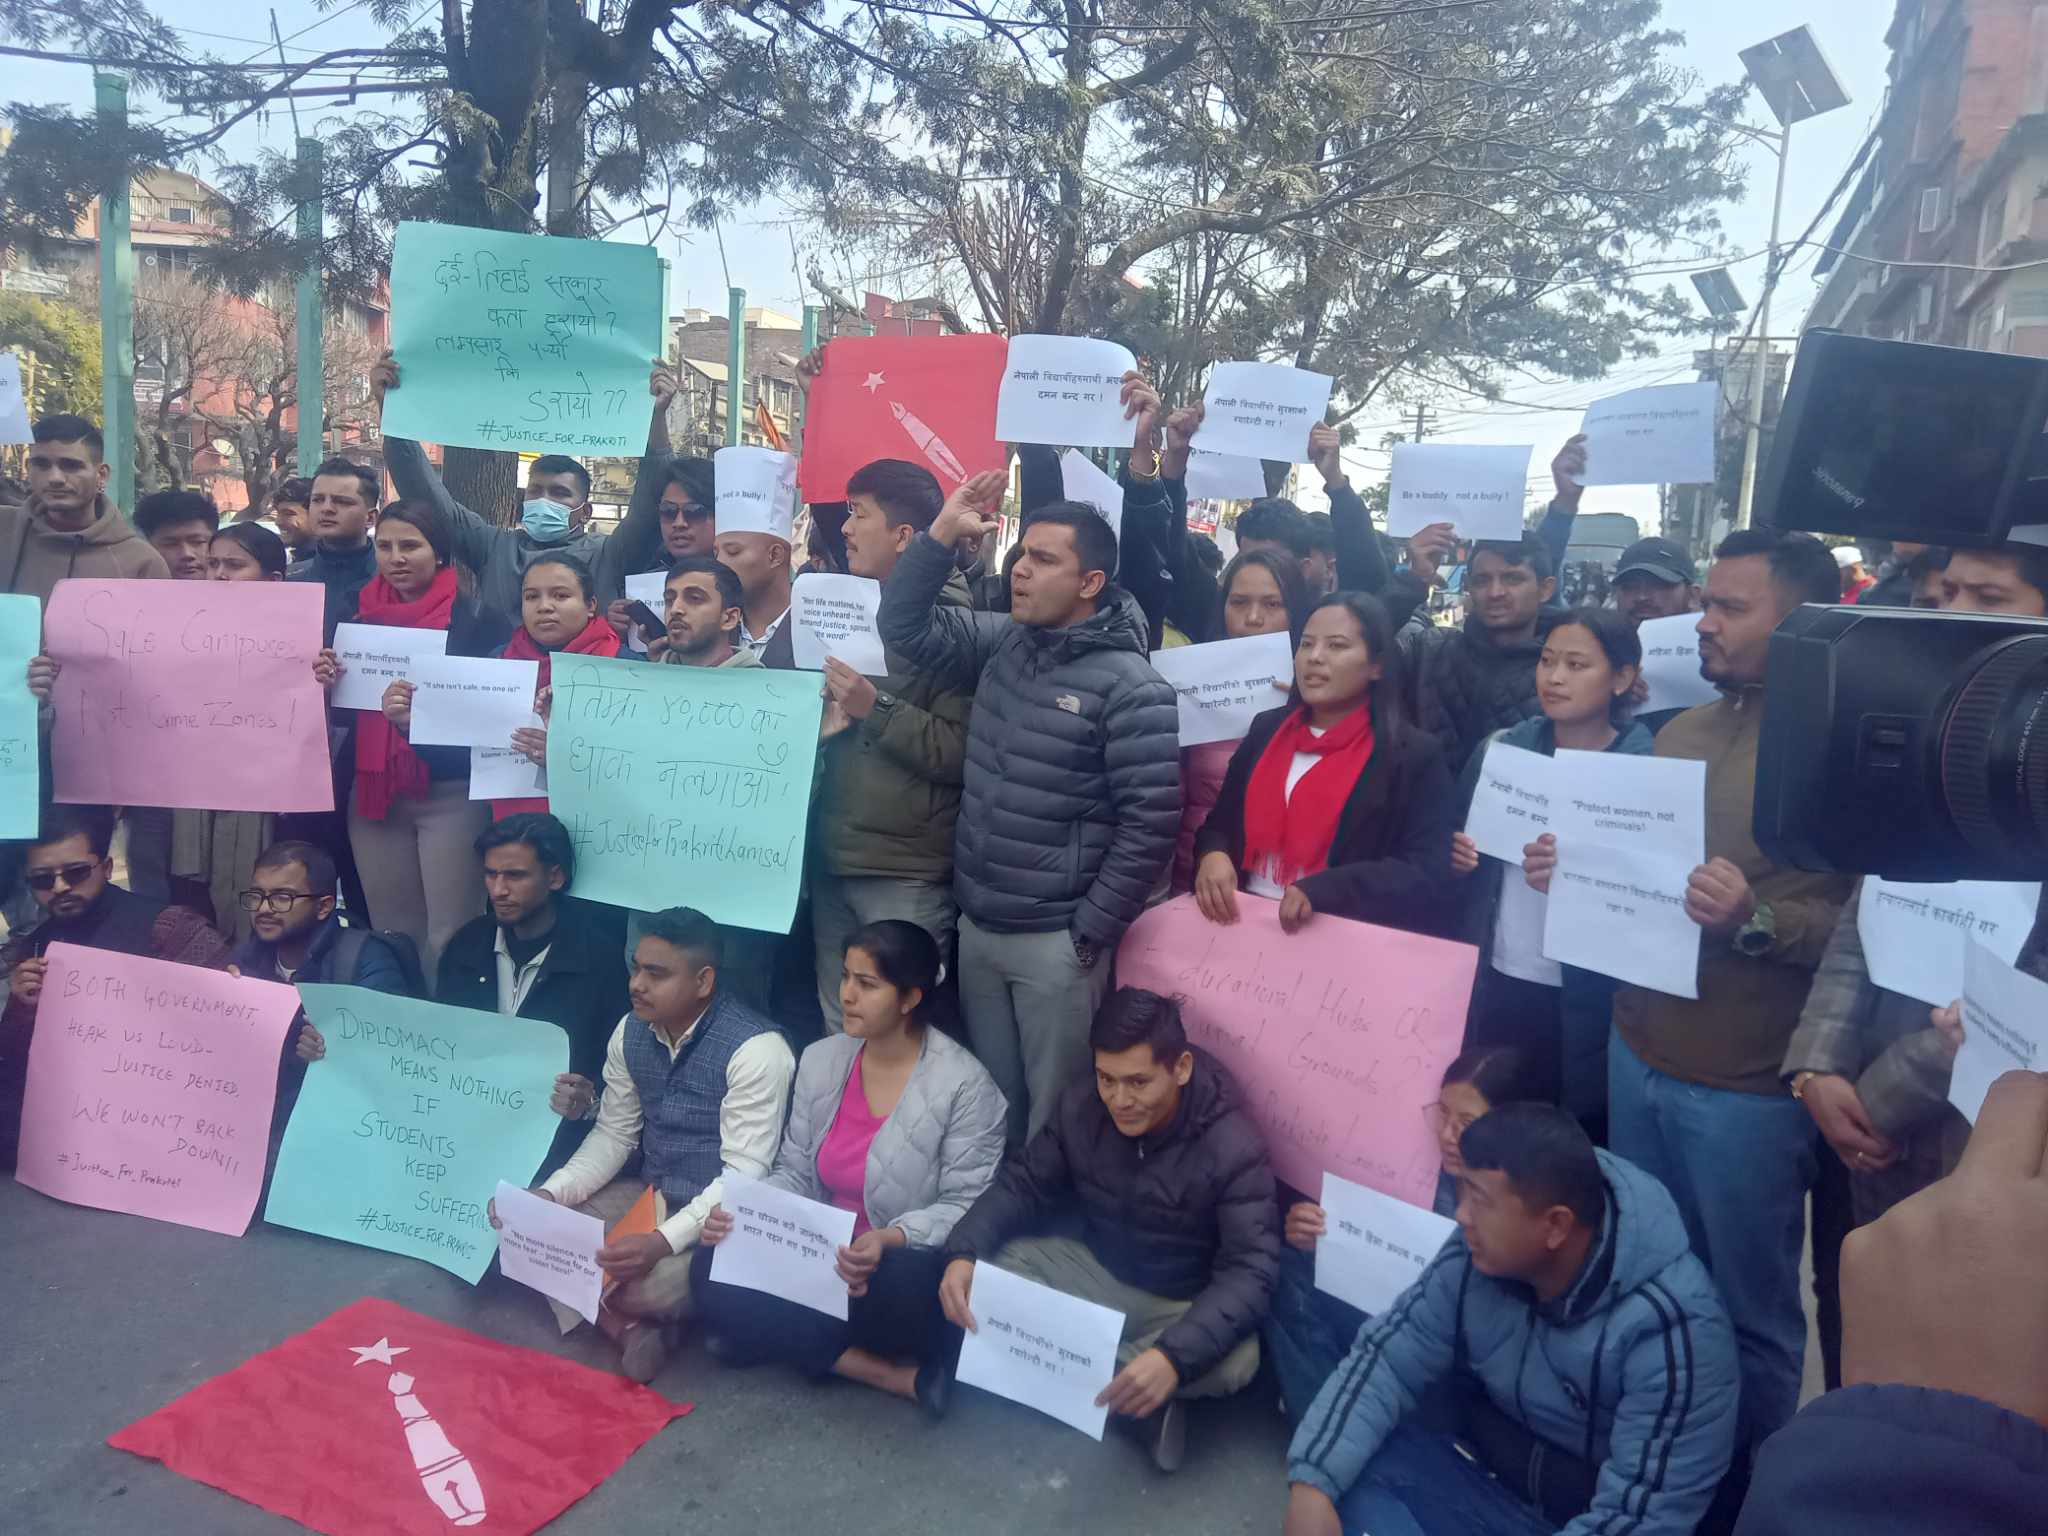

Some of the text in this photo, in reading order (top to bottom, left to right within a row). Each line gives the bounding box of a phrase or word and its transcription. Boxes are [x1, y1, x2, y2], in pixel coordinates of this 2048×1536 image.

[335, 1006, 457, 1061] DIPLOMACY
[390, 1055, 525, 1110] MEANS NOTHING
[411, 1093, 441, 1116] IF
[352, 1111, 456, 1160] STUDENTS
[404, 1155, 448, 1184] KEEP
